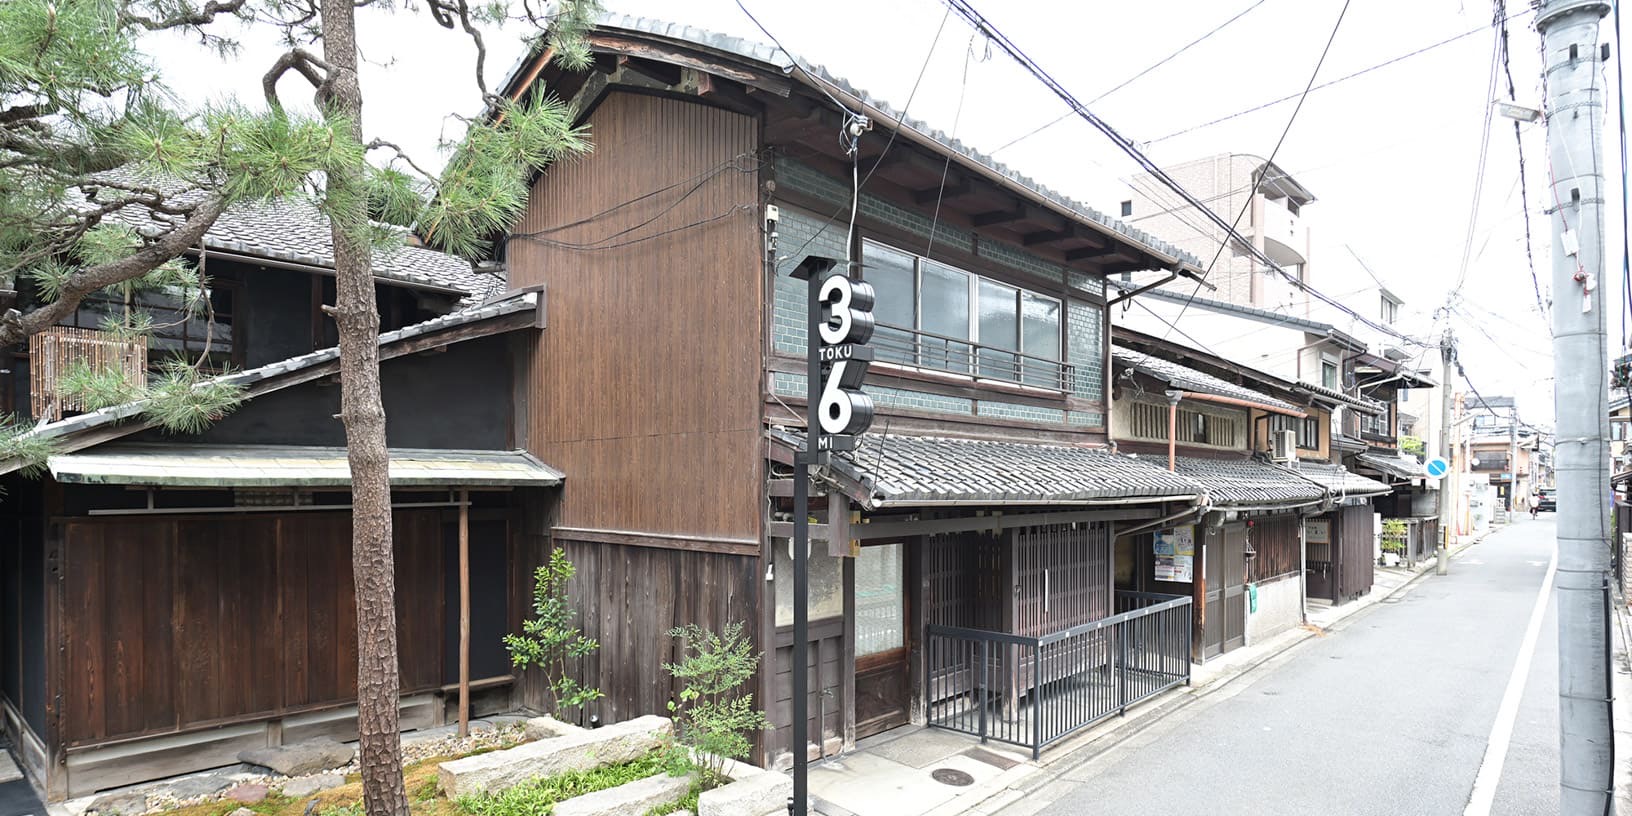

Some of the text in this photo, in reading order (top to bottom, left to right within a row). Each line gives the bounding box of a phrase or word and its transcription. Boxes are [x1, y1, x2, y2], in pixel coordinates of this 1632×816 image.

[818, 274, 852, 344] 3
[819, 345, 852, 361] TOKU
[818, 360, 852, 434] 6
[818, 437, 833, 450] MI
